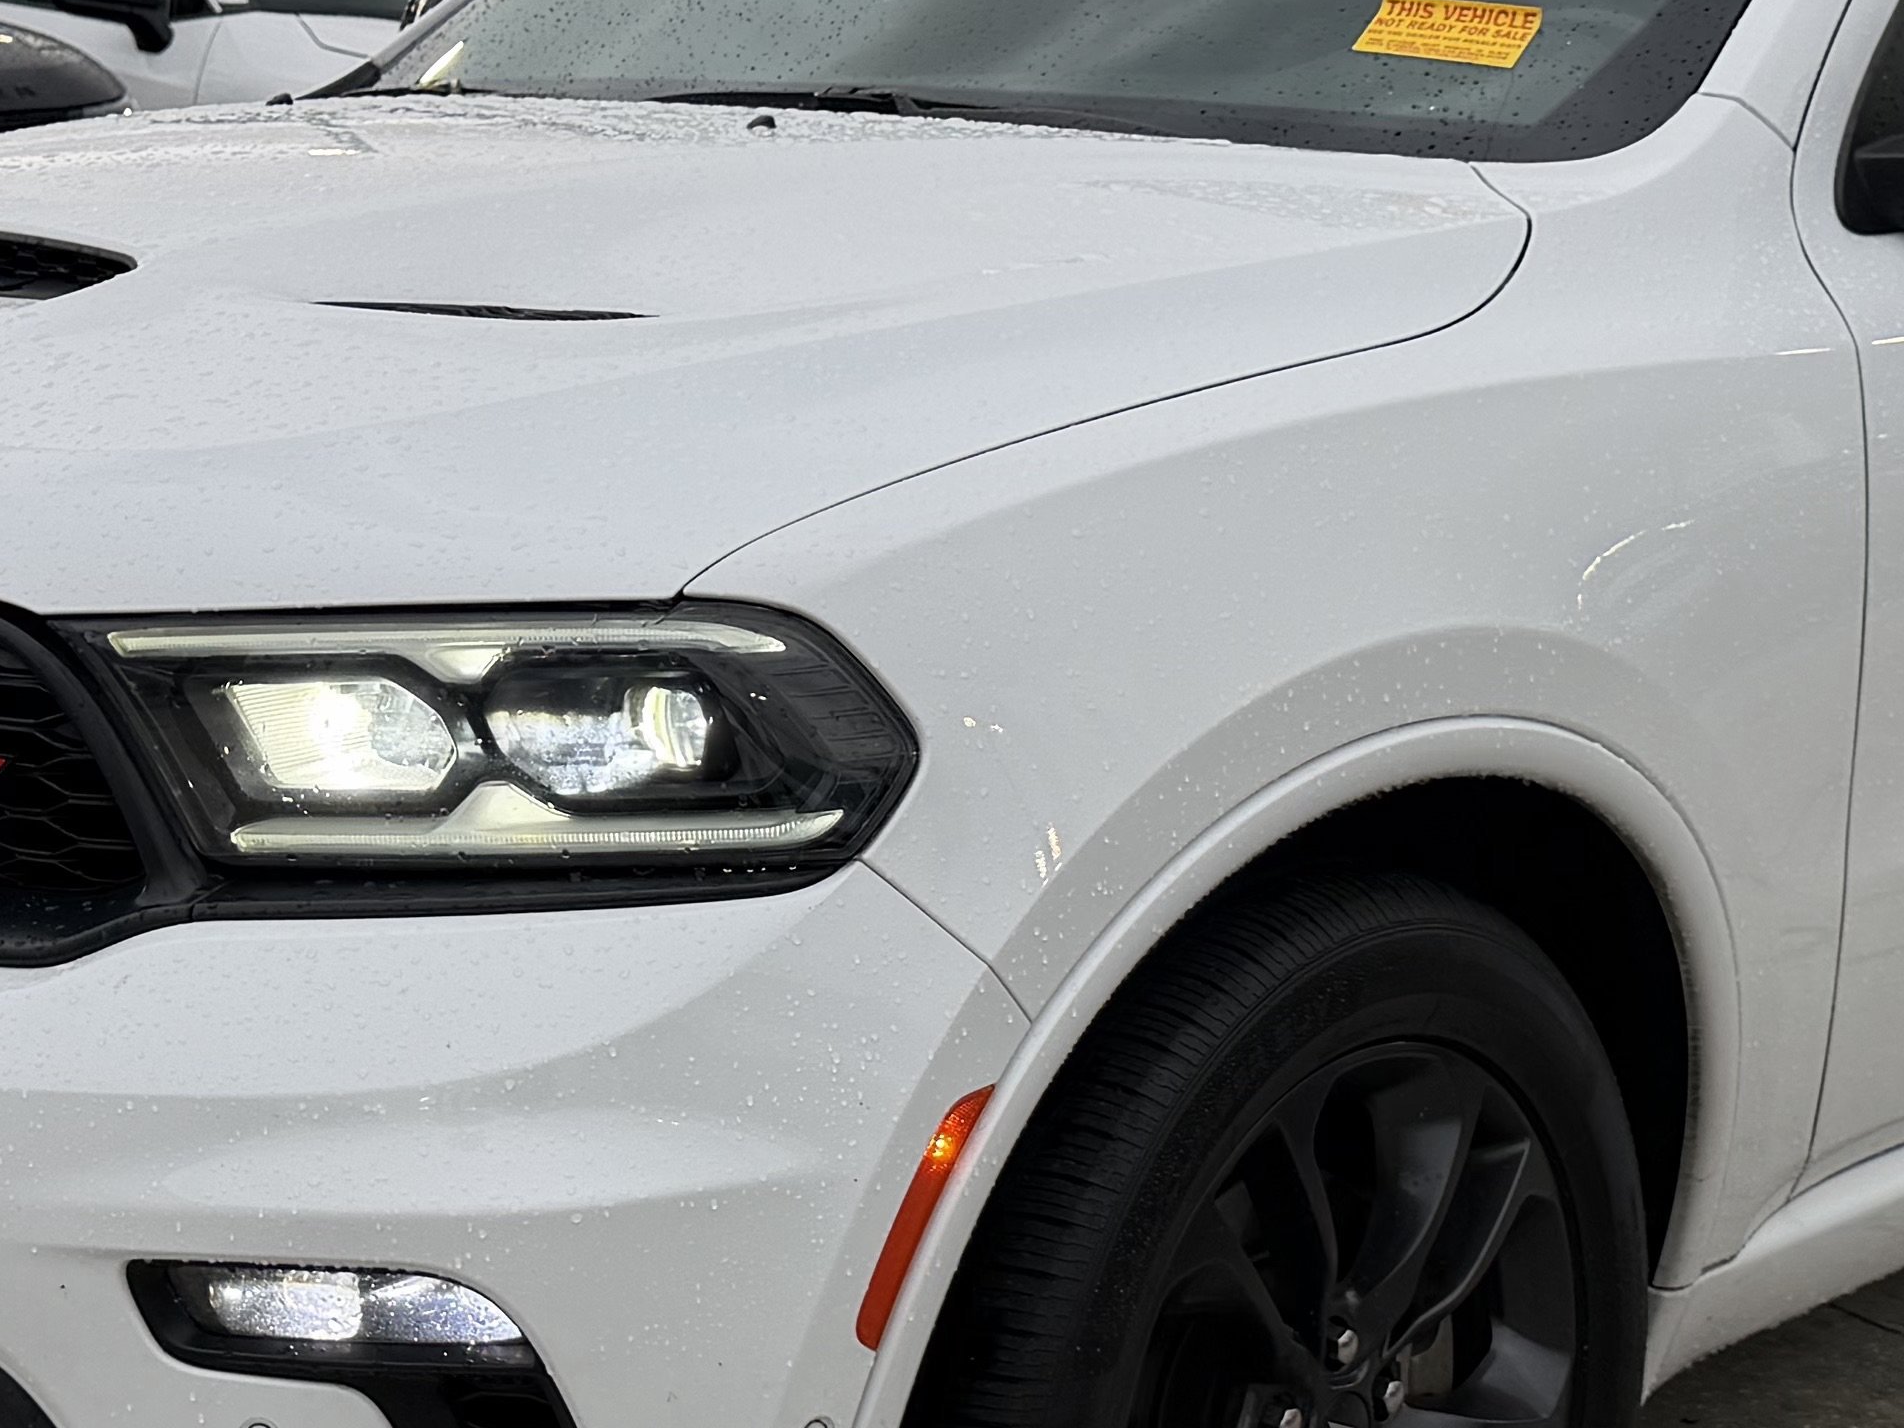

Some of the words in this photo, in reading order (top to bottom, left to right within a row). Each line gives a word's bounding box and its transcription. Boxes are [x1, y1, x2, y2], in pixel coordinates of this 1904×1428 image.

[1386, 0, 1436, 19] THIS
[1443, 4, 1538, 30] VEHICLE
[1375, 17, 1404, 28] NOT
[1406, 20, 1456, 32] READY
[1457, 25, 1490, 36] FOR
[1491, 29, 1532, 42] SALE
